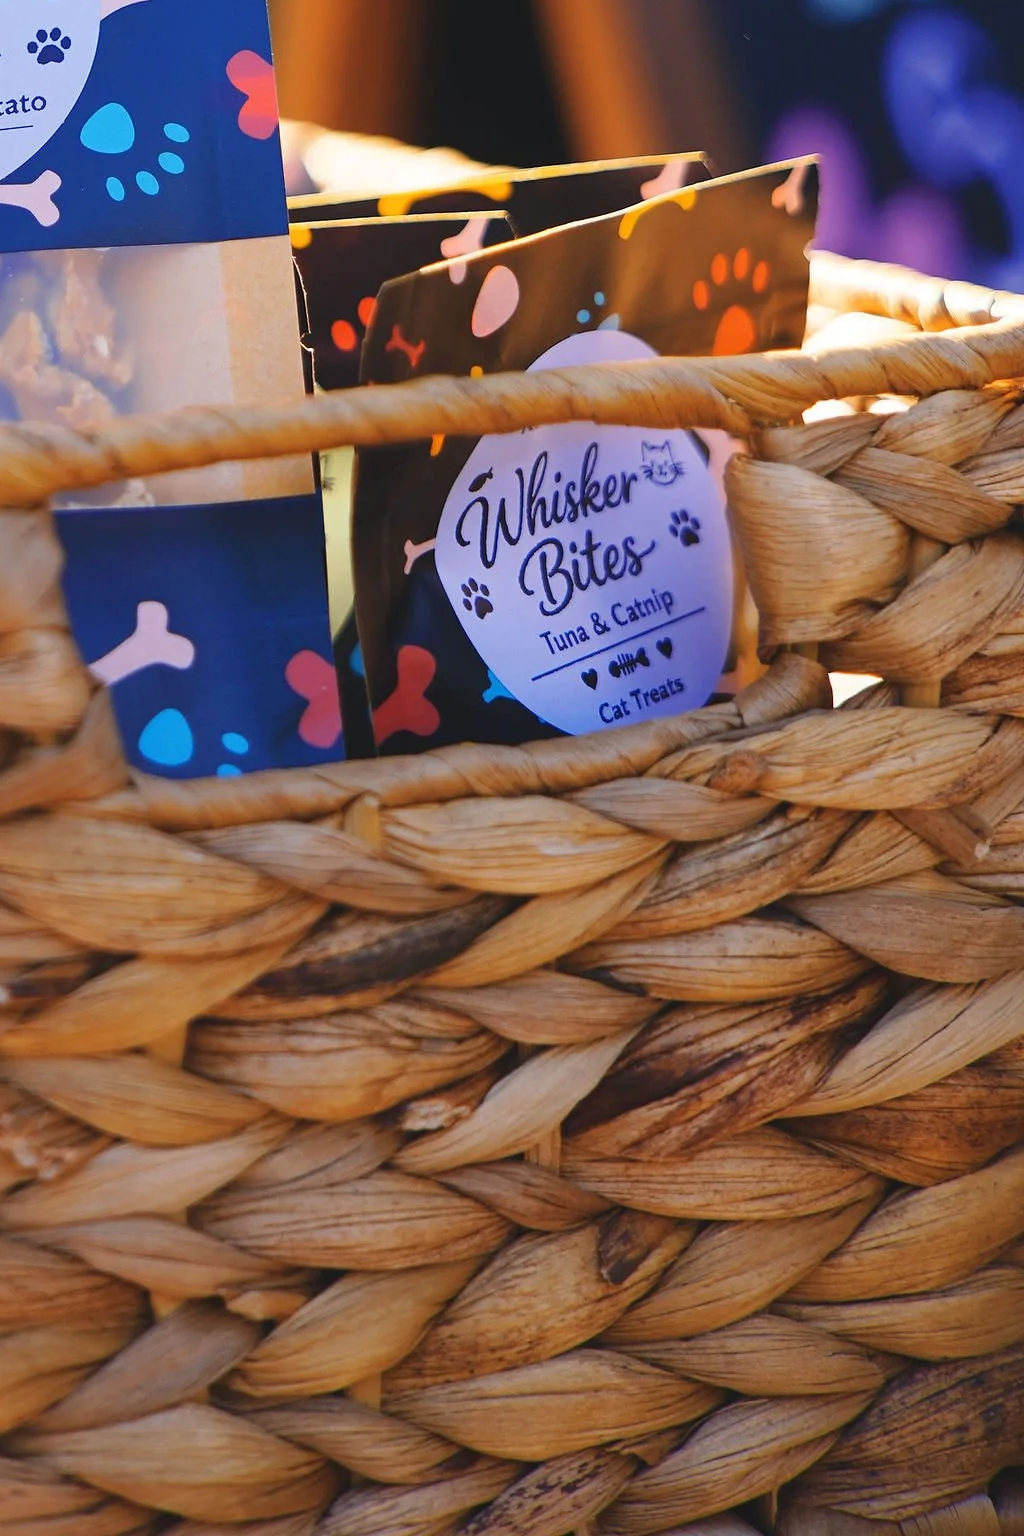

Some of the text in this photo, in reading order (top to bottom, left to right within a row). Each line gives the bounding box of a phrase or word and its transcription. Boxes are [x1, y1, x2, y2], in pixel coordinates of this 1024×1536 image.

[455, 441, 638, 569] Whisker
[518, 529, 656, 617] Bites
[538, 588, 675, 655] Tuna & Catnip
[598, 677, 685, 724] Cat Treats
